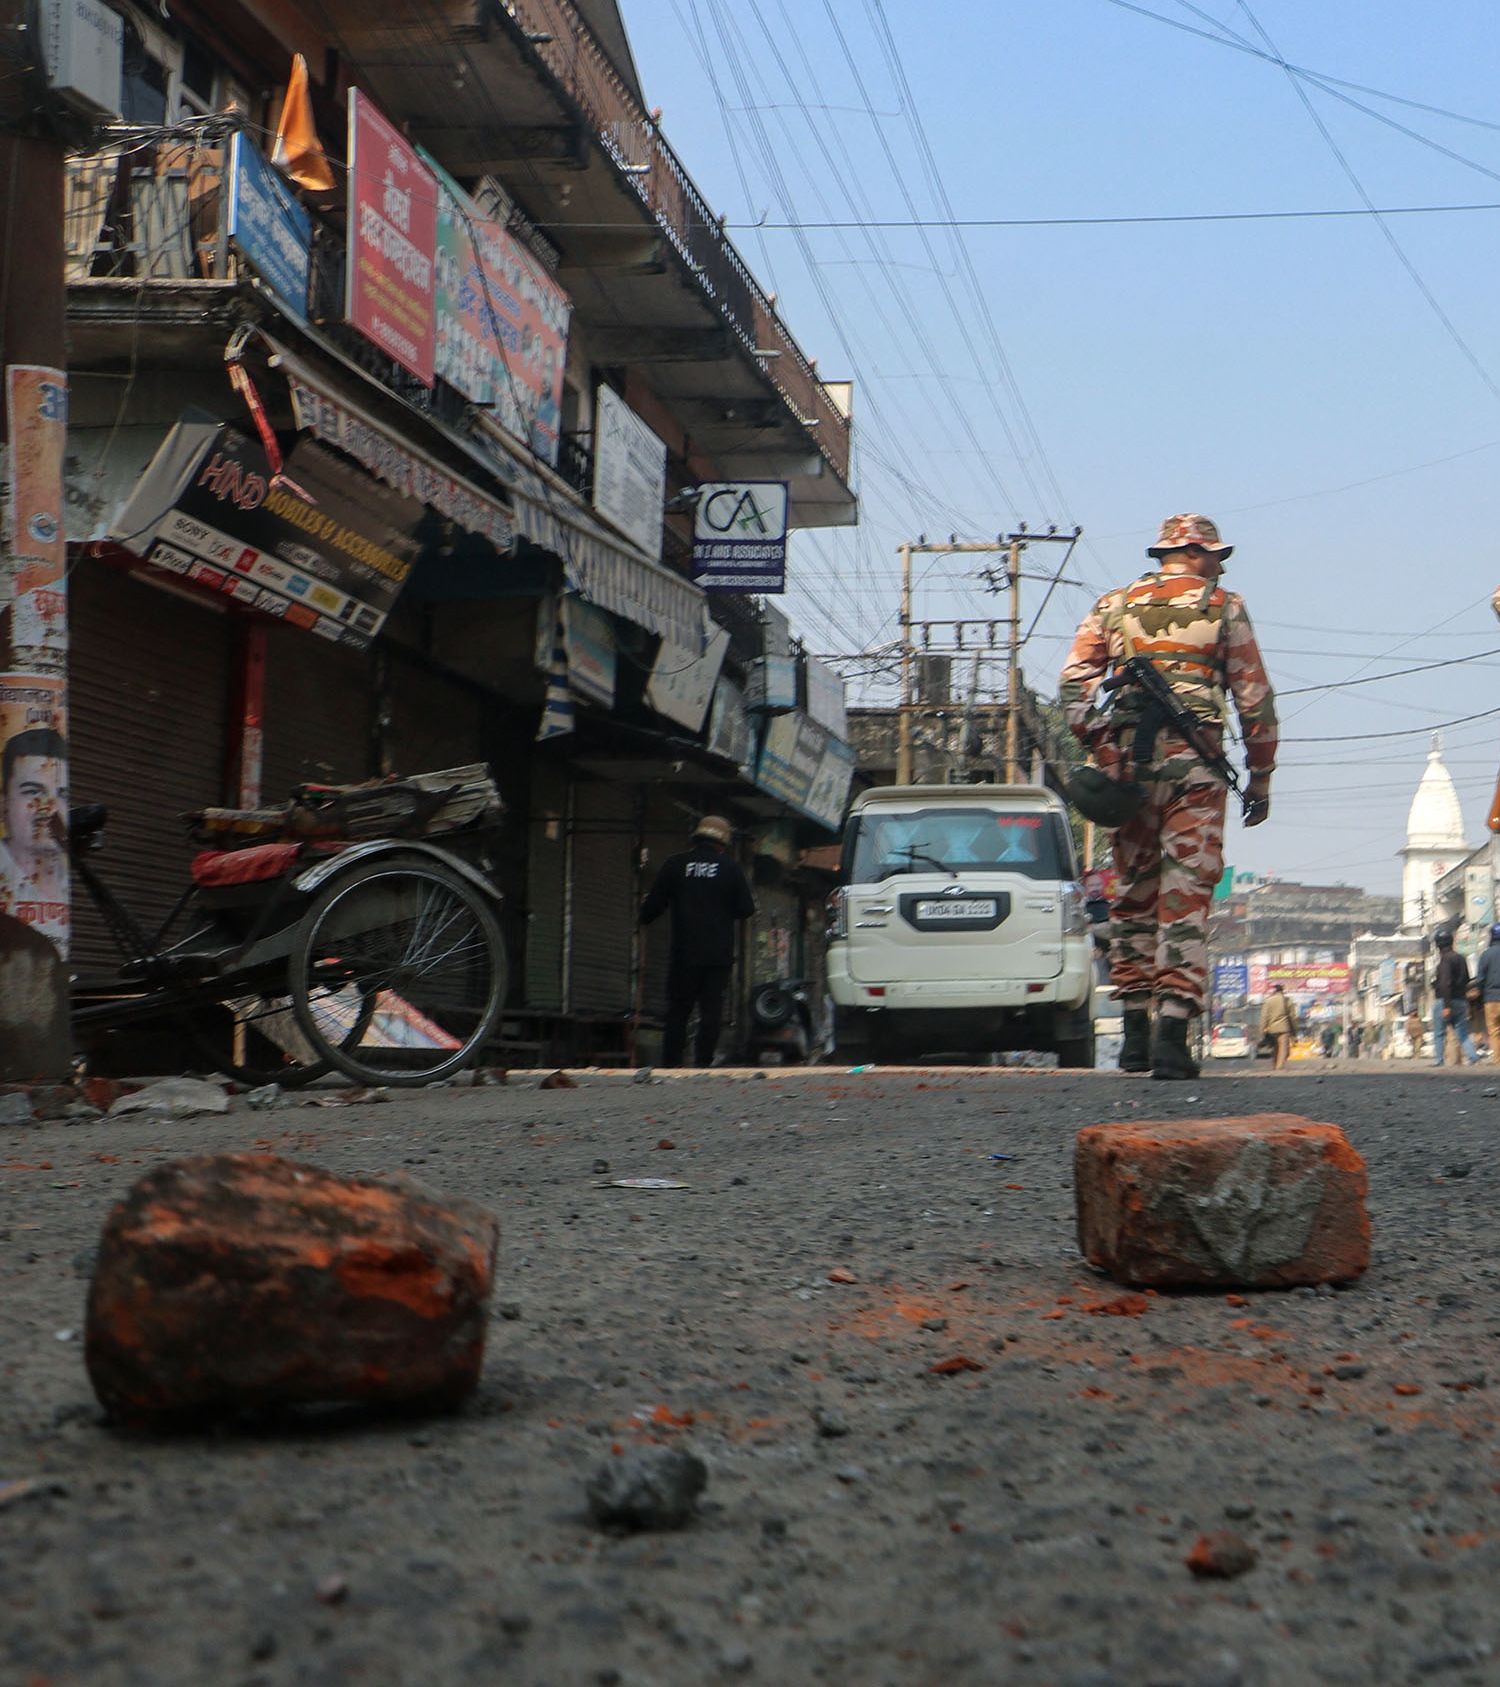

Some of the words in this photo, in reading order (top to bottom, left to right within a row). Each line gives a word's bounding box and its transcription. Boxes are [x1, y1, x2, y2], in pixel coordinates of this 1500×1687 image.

[198, 452, 269, 511] HIND
[705, 489, 769, 534] CA
[685, 862, 720, 878] FIRE
